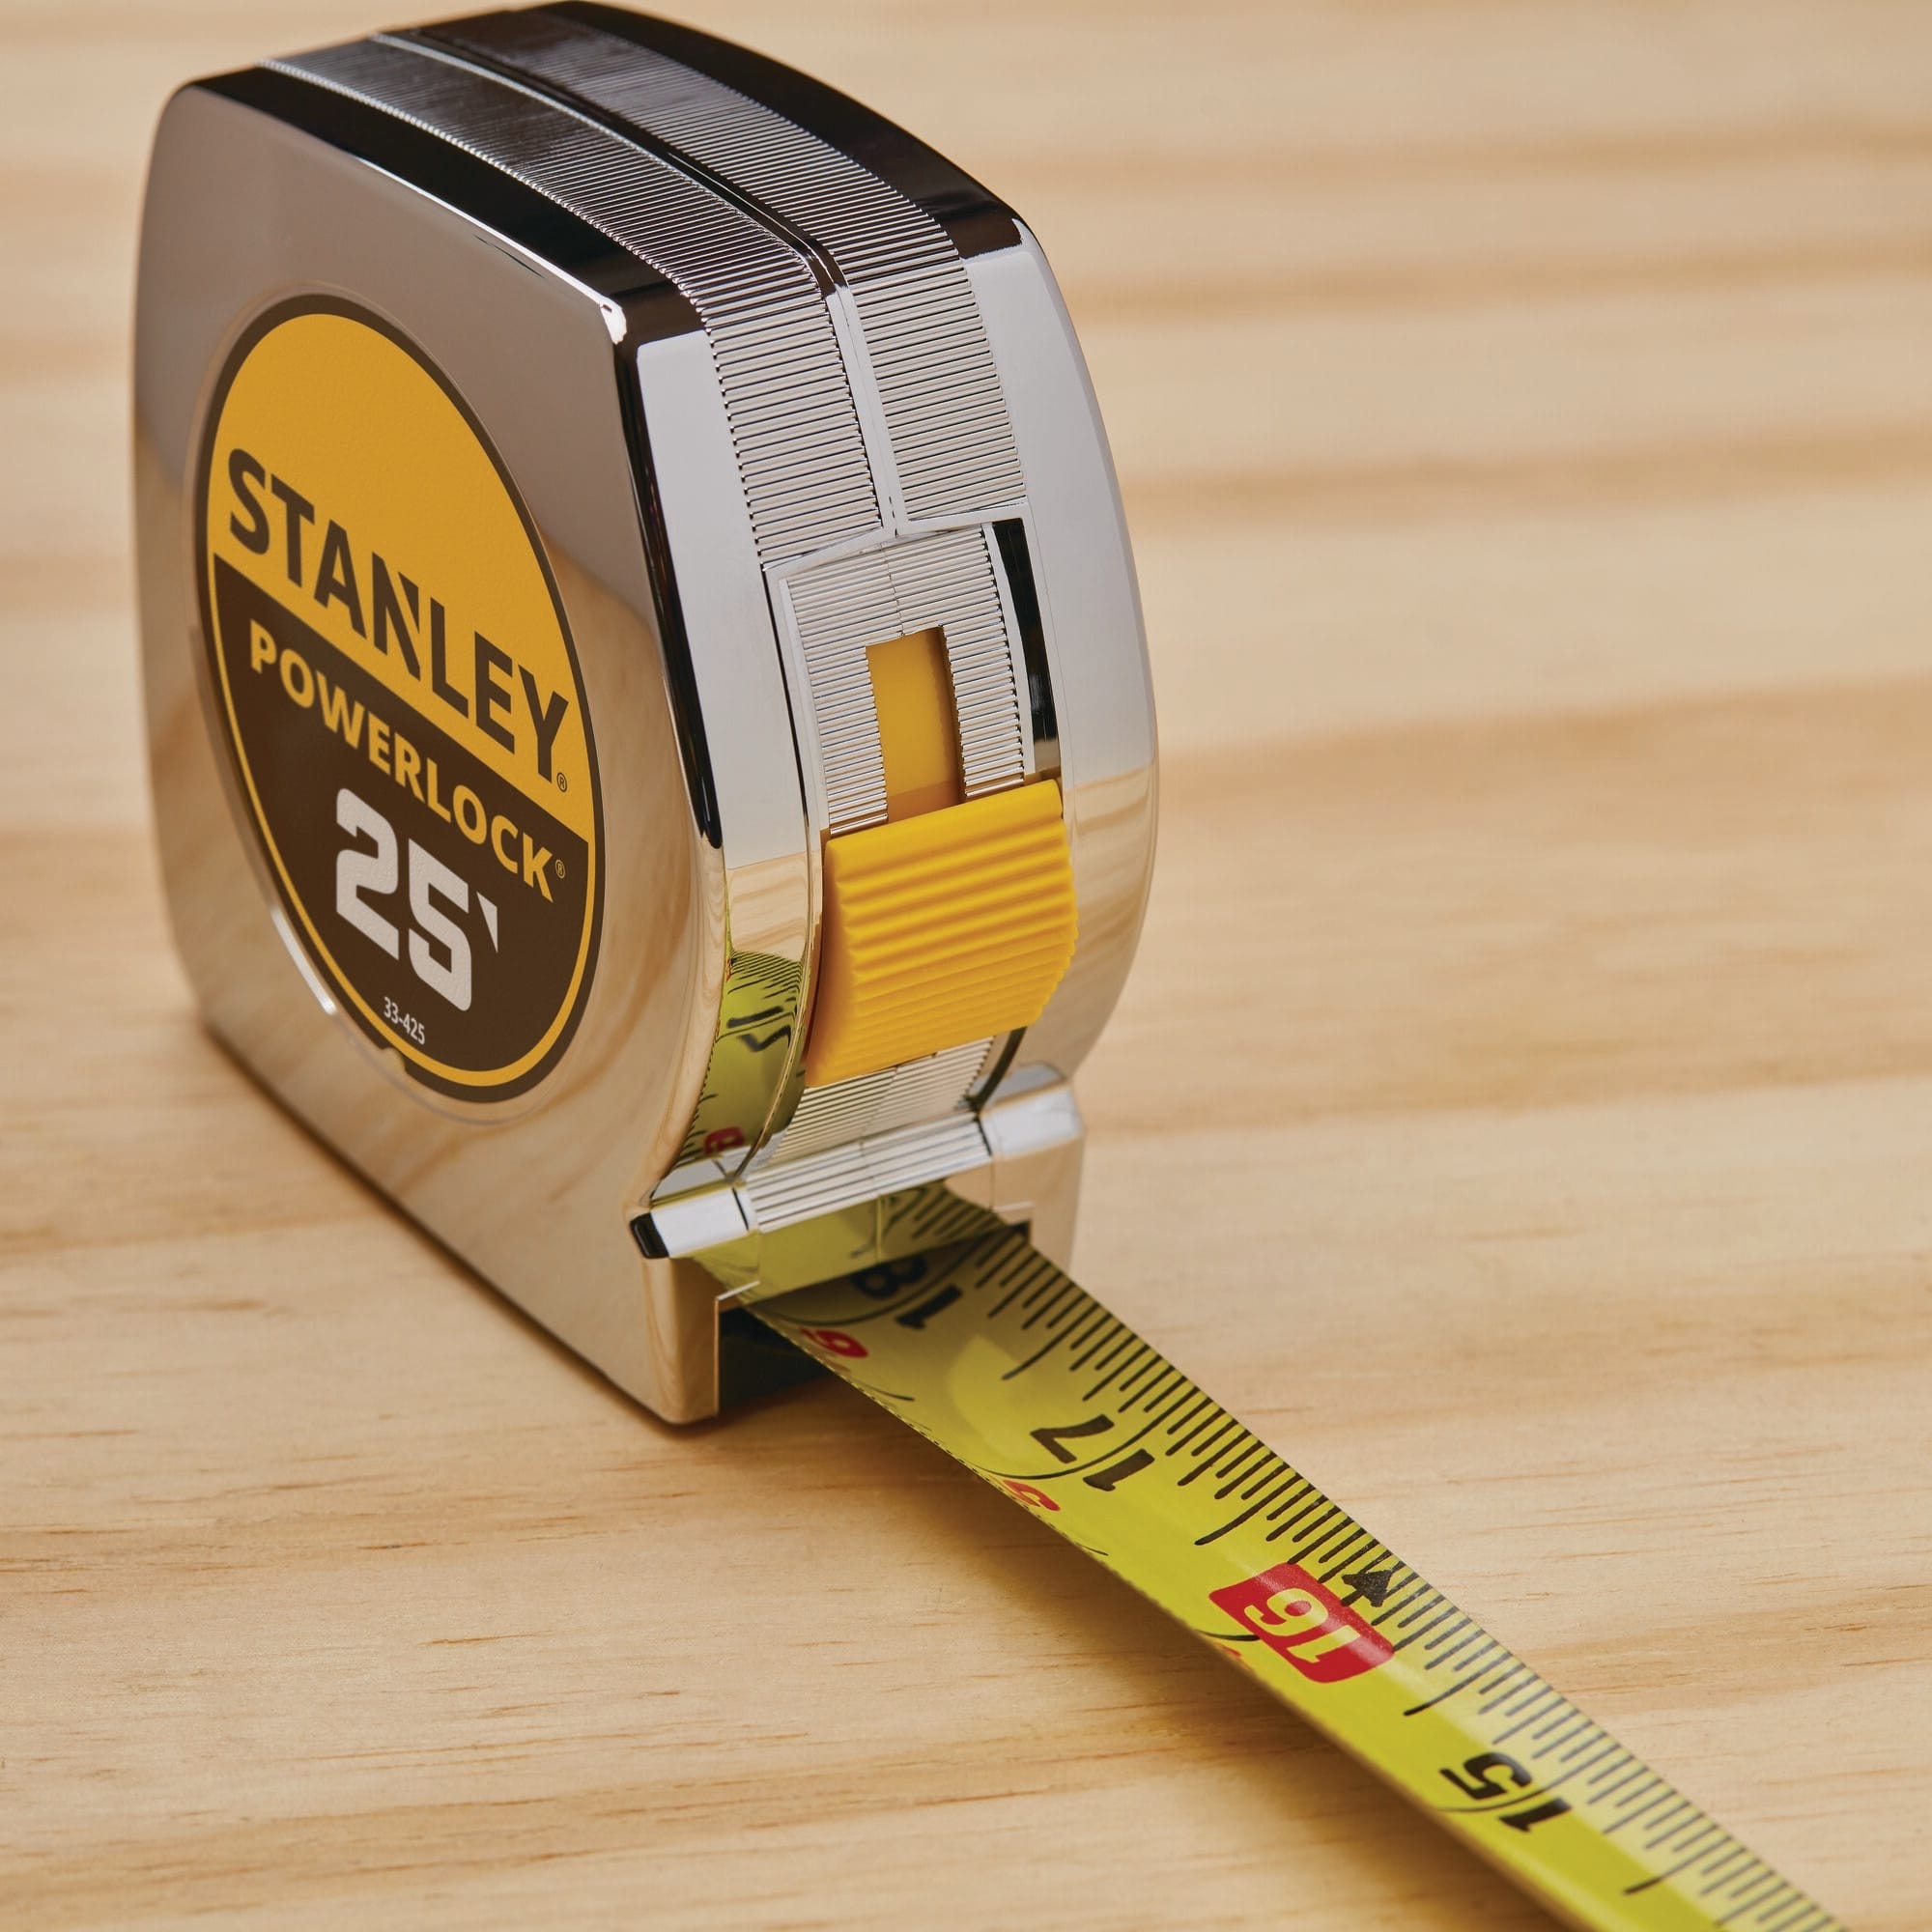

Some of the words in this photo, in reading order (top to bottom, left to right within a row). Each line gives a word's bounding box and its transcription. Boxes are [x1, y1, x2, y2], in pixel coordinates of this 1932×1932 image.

[384, 996, 425, 1045] 33-425
[1030, 1413, 1156, 1492] 17
[1243, 1587, 1362, 1664] 16
[1438, 1751, 1573, 1833] 15
